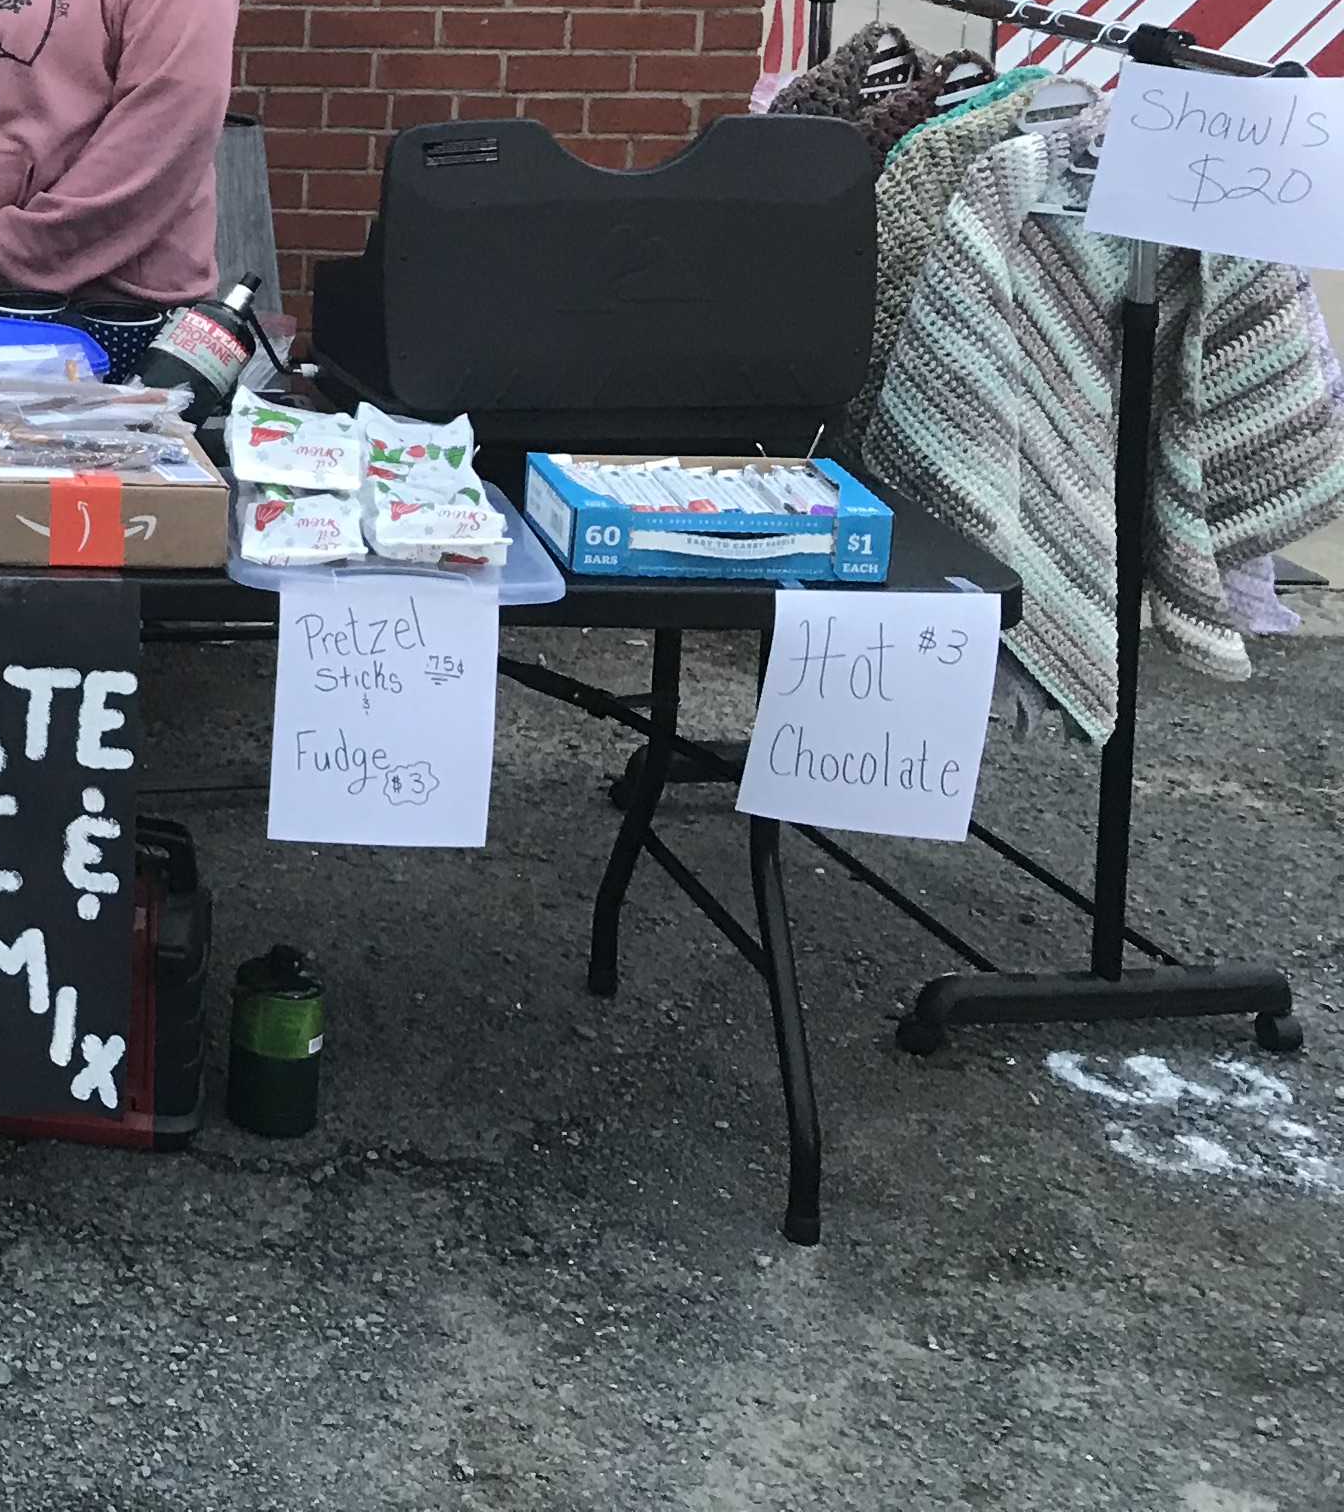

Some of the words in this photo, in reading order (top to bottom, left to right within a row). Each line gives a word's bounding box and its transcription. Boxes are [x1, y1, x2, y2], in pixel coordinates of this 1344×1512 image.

[1130, 89, 1330, 148] Shawls
[1168, 154, 1313, 212] $20
[184, 312, 213, 332] TEN
[166, 332, 198, 356] FUEL
[175, 320, 234, 367] PROPANE
[585, 525, 621, 546] 60
[848, 533, 873, 555] $1
[583, 554, 618, 565] BARS
[842, 562, 879, 574] EACH
[296, 596, 426, 660] Pretzel
[778, 616, 896, 702] Hot
[918, 626, 969, 665] $3
[315, 660, 403, 694] Sticks
[297, 728, 390, 795] Fudge
[769, 723, 960, 797] Chocolate
[391, 773, 426, 794] $3
